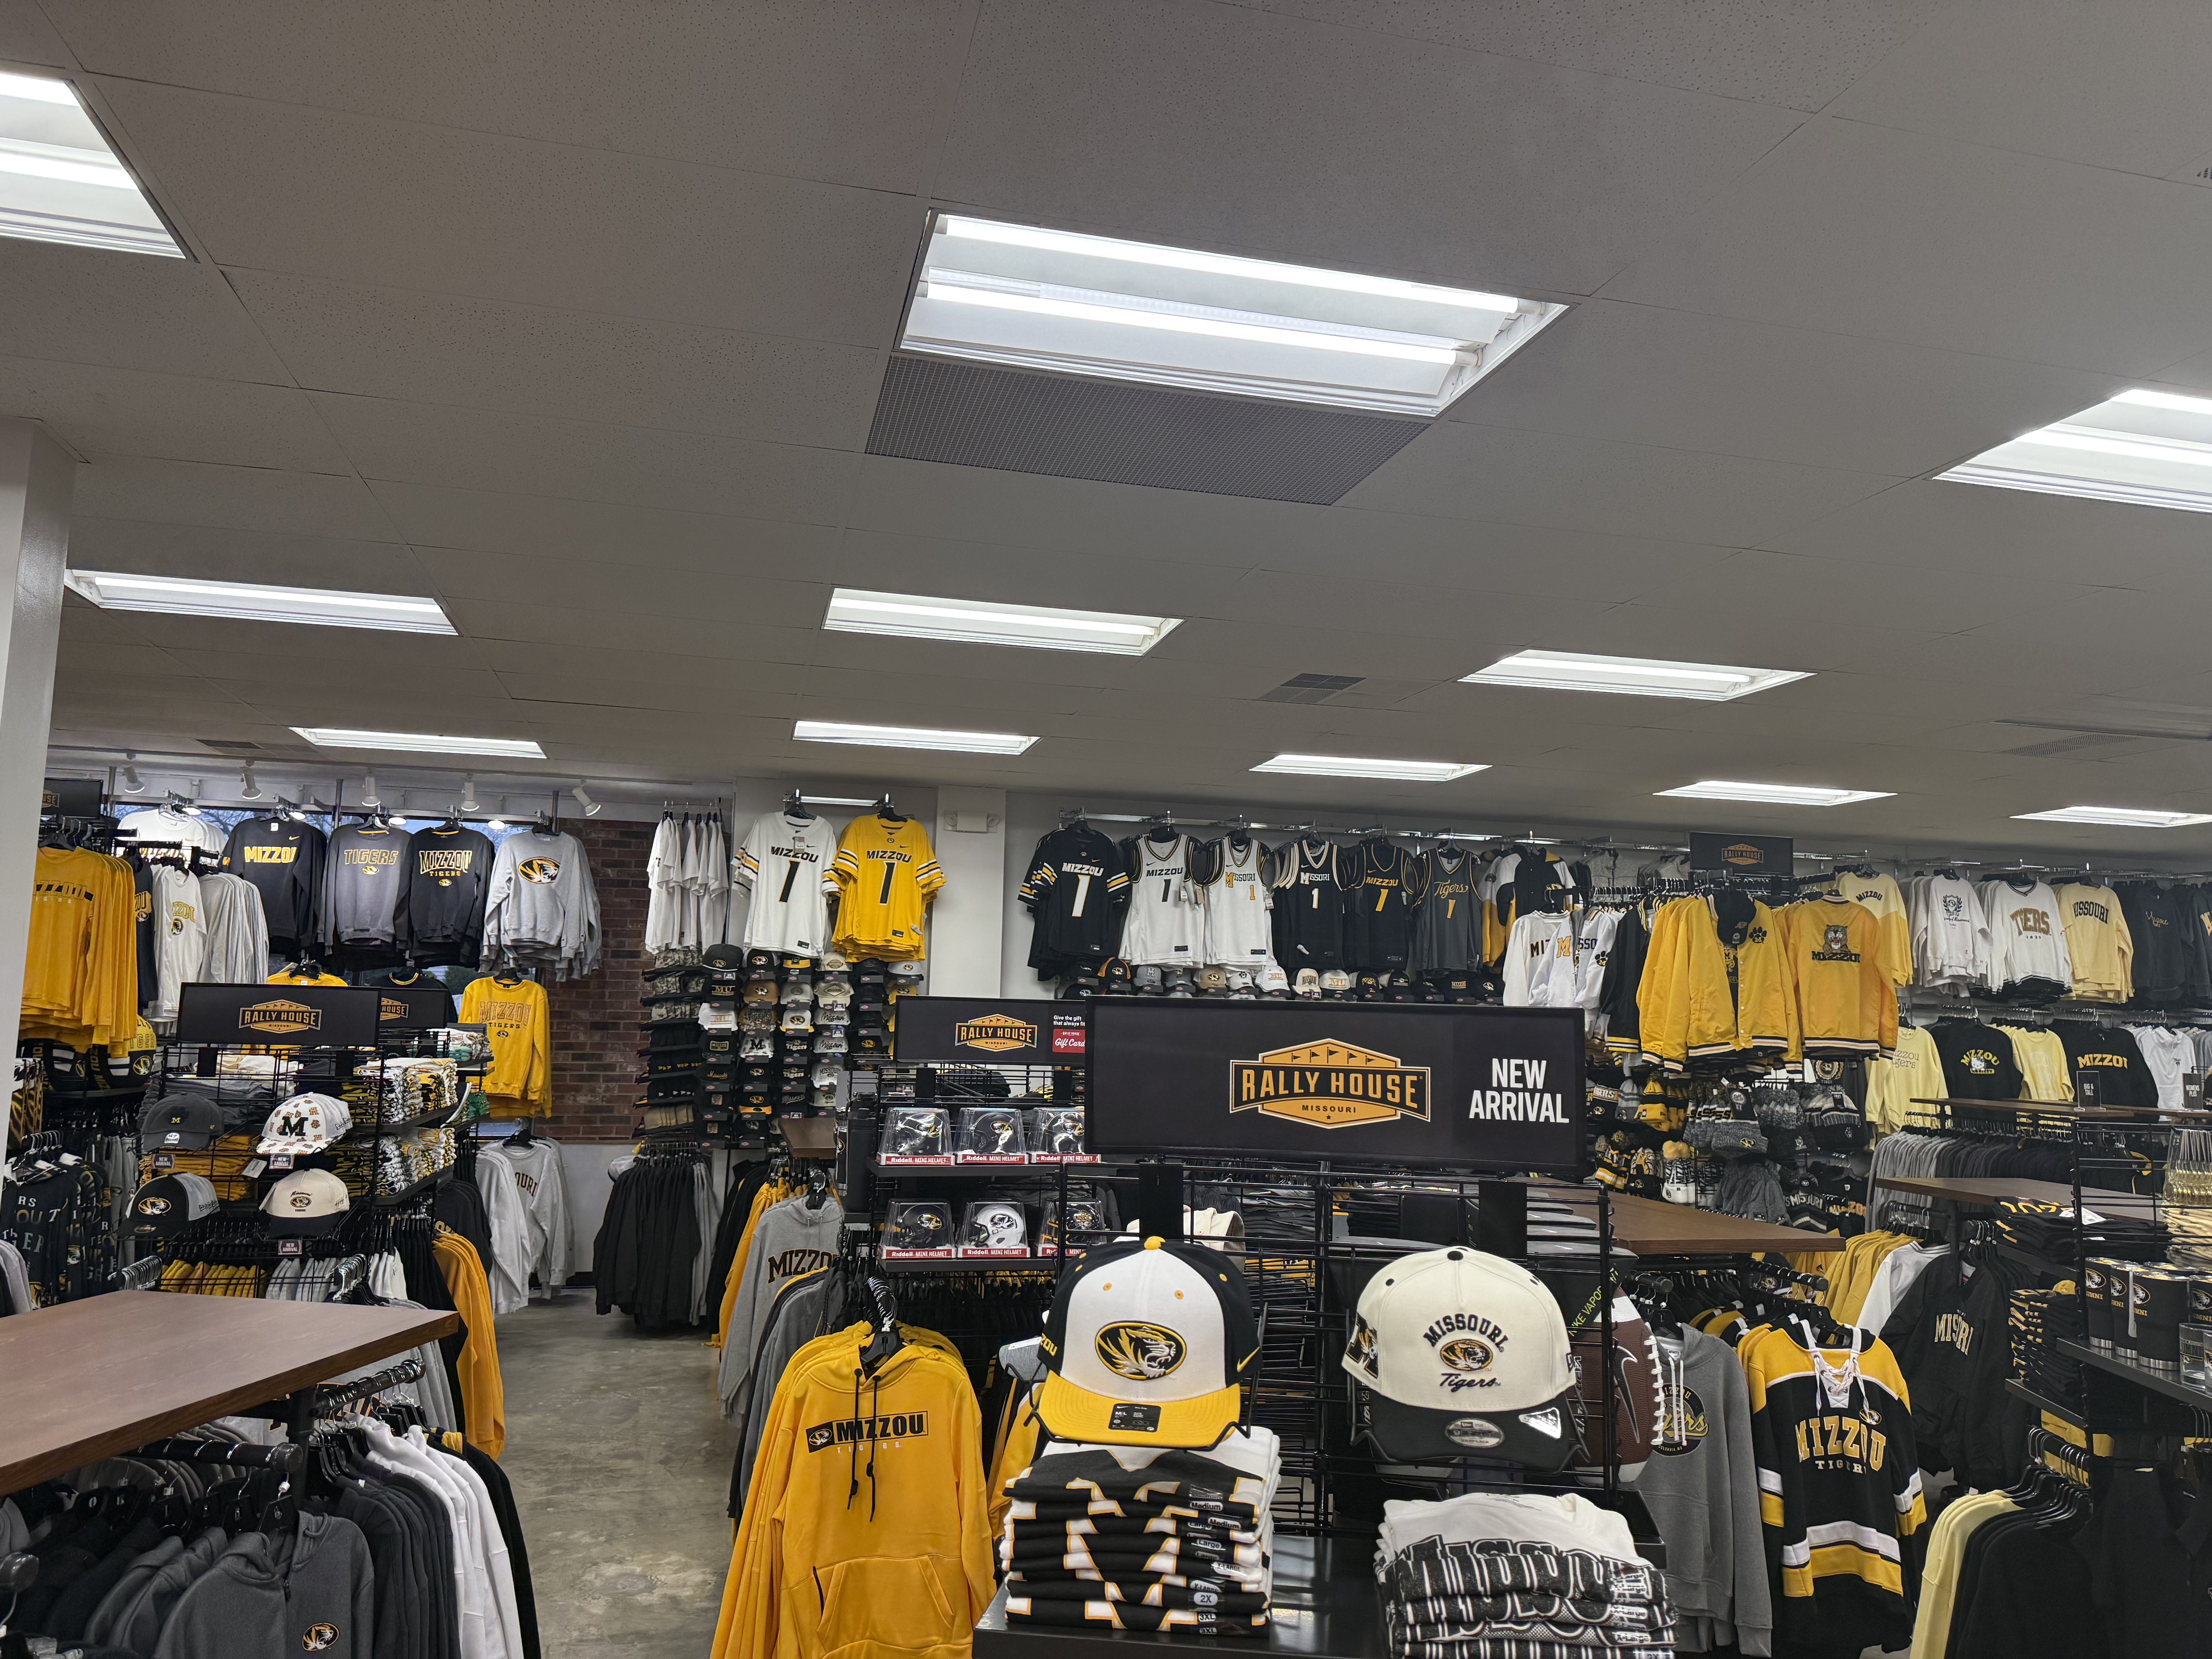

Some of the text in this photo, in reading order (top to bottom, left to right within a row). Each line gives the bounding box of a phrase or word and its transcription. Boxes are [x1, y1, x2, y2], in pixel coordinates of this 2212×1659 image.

[344, 849, 399, 865] TIGERS
[419, 850, 472, 875] MIZZOU
[770, 845, 819, 863] MIZZOU
[866, 850, 912, 863] MIZZOU
[1724, 850, 1761, 860] RALLY HOUSE
[1061, 862, 1104, 877] MIZZOU
[1146, 867, 1183, 877] MIZZOU
[778, 860, 800, 903] 1
[879, 861, 897, 905] 1
[1365, 876, 1398, 887] MIZZOU
[1434, 880, 1469, 899] Tigers
[1071, 874, 1091, 917] 1
[1162, 879, 1171, 902] 1
[1249, 884, 1255, 900] 1
[1312, 888, 1319, 909] 1
[1856, 890, 1883, 902] MIZZOU
[1556, 935, 1571, 958] M
[244, 1011, 316, 1026] RALLY HOUSE
[479, 1001, 531, 1027] MIZZOU
[961, 1027, 1032, 1042] RALLY HOUSE
[1054, 1038, 1085, 1049] Gift Card
[1960, 1049, 2000, 1066] MIZZOU
[1491, 1058, 1547, 1089] NEW
[1242, 1069, 1419, 1109] RALLY HOUSE
[1302, 1104, 1357, 1114] MISSOURI
[1469, 1090, 1570, 1123] ARRIVAL
[278, 1116, 309, 1137] M
[768, 1248, 835, 1284] MIZZO
[1423, 1313, 1509, 1348] MISSOURI
[1439, 1373, 1497, 1393] Tigers
[836, 1414, 925, 1443] MIZZOU
[836, 1441, 902, 1453] TIGRS
[1815, 1460, 1867, 1474] TIGR
[1191, 1502, 1221, 1510] Medium
[1209, 1518, 1240, 1529] Medium
[1199, 1539, 1220, 1549] Large
[1200, 1595, 1212, 1603] 2X
